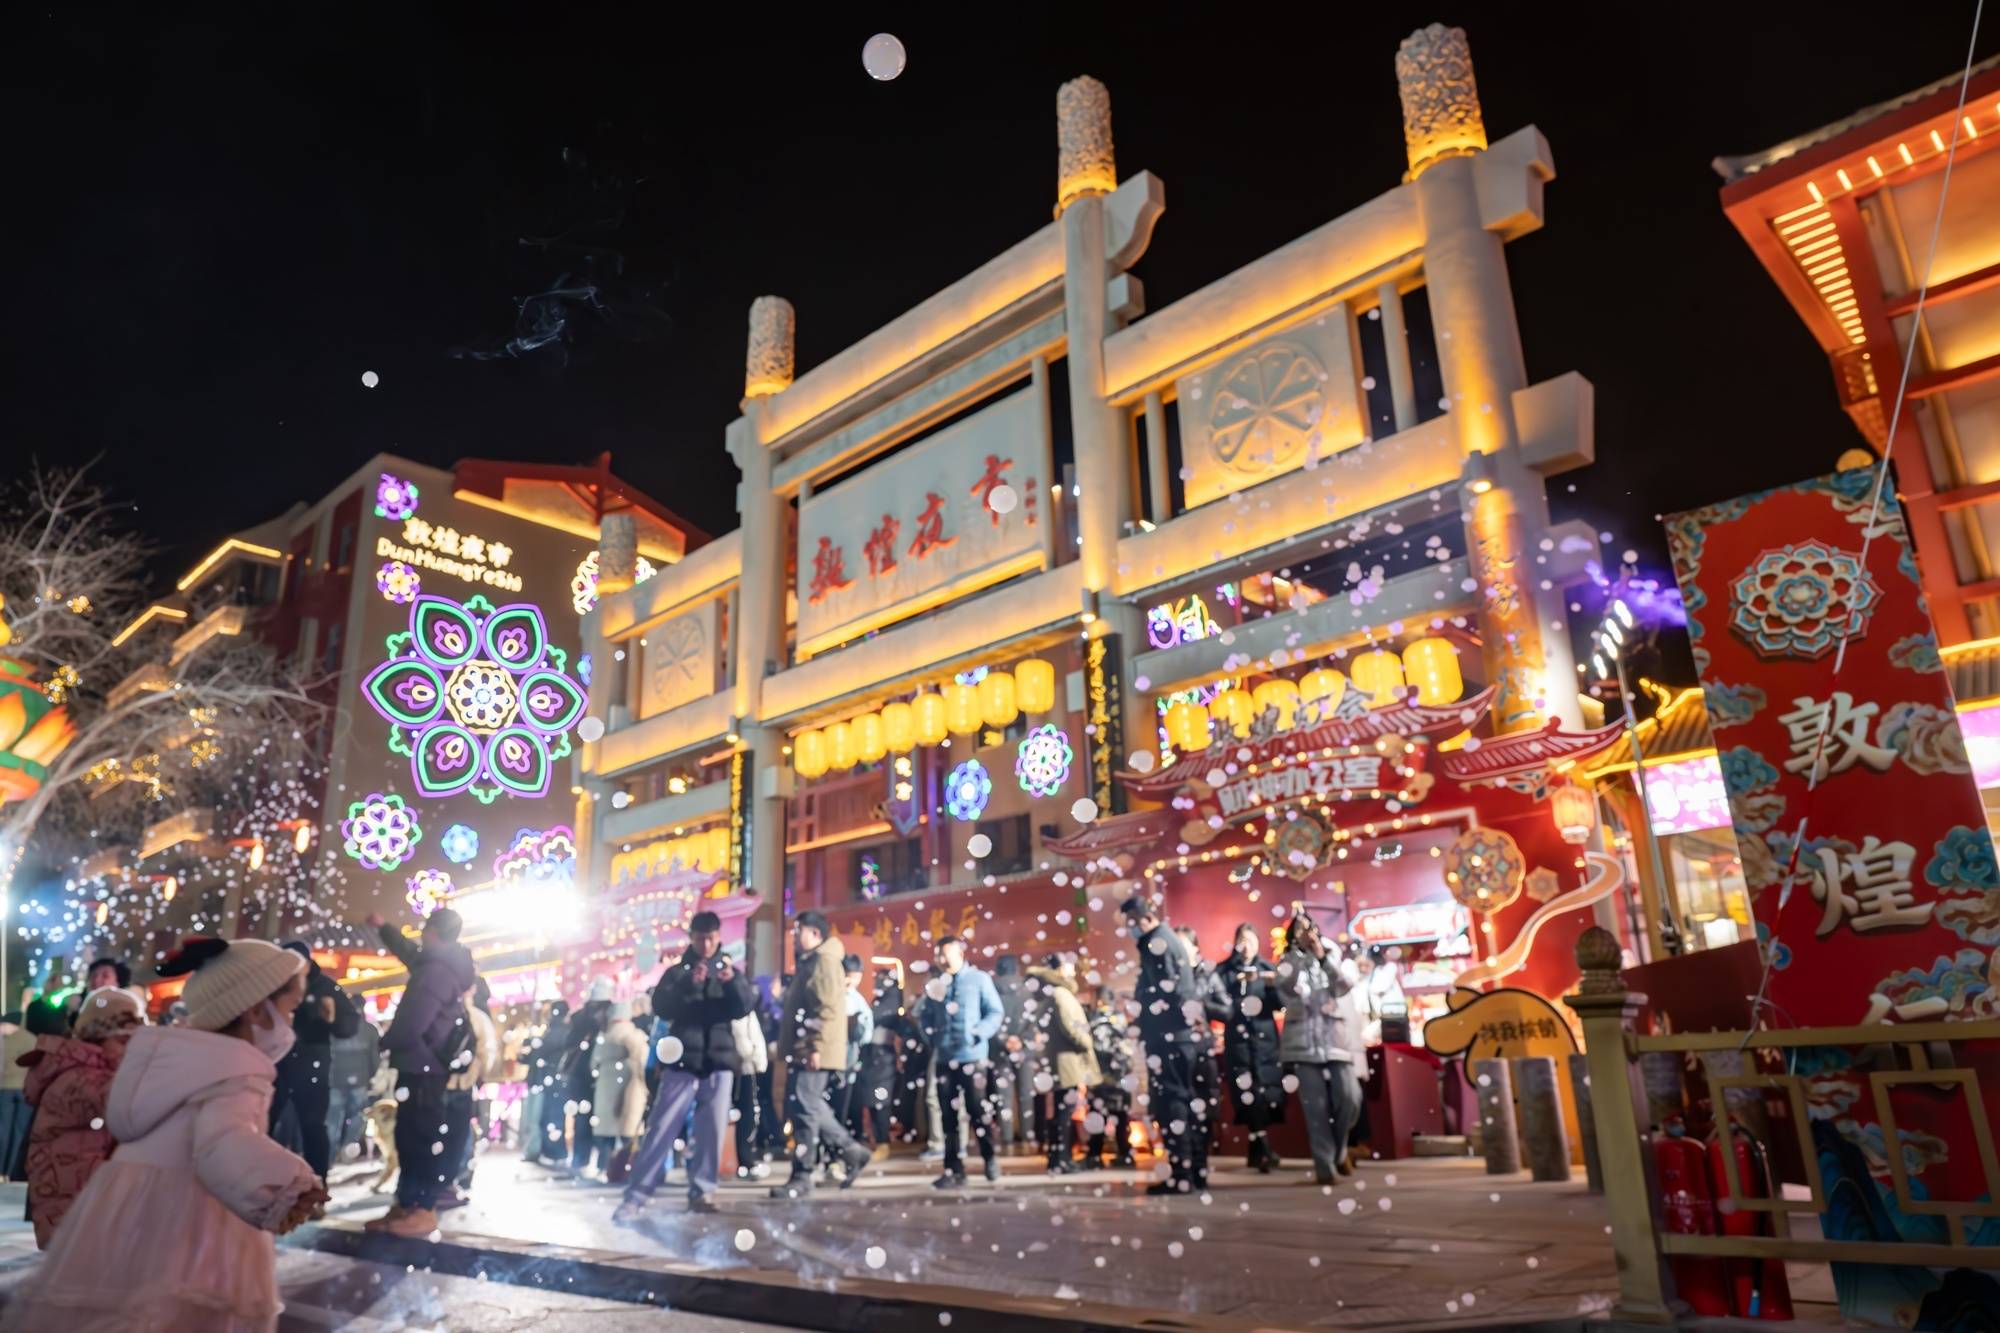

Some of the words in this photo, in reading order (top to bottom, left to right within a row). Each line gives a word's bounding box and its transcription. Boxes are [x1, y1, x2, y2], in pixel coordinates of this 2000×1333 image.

[402, 516, 513, 568] 敦煌夜市
[1217, 756, 1383, 815] 财神办公室
